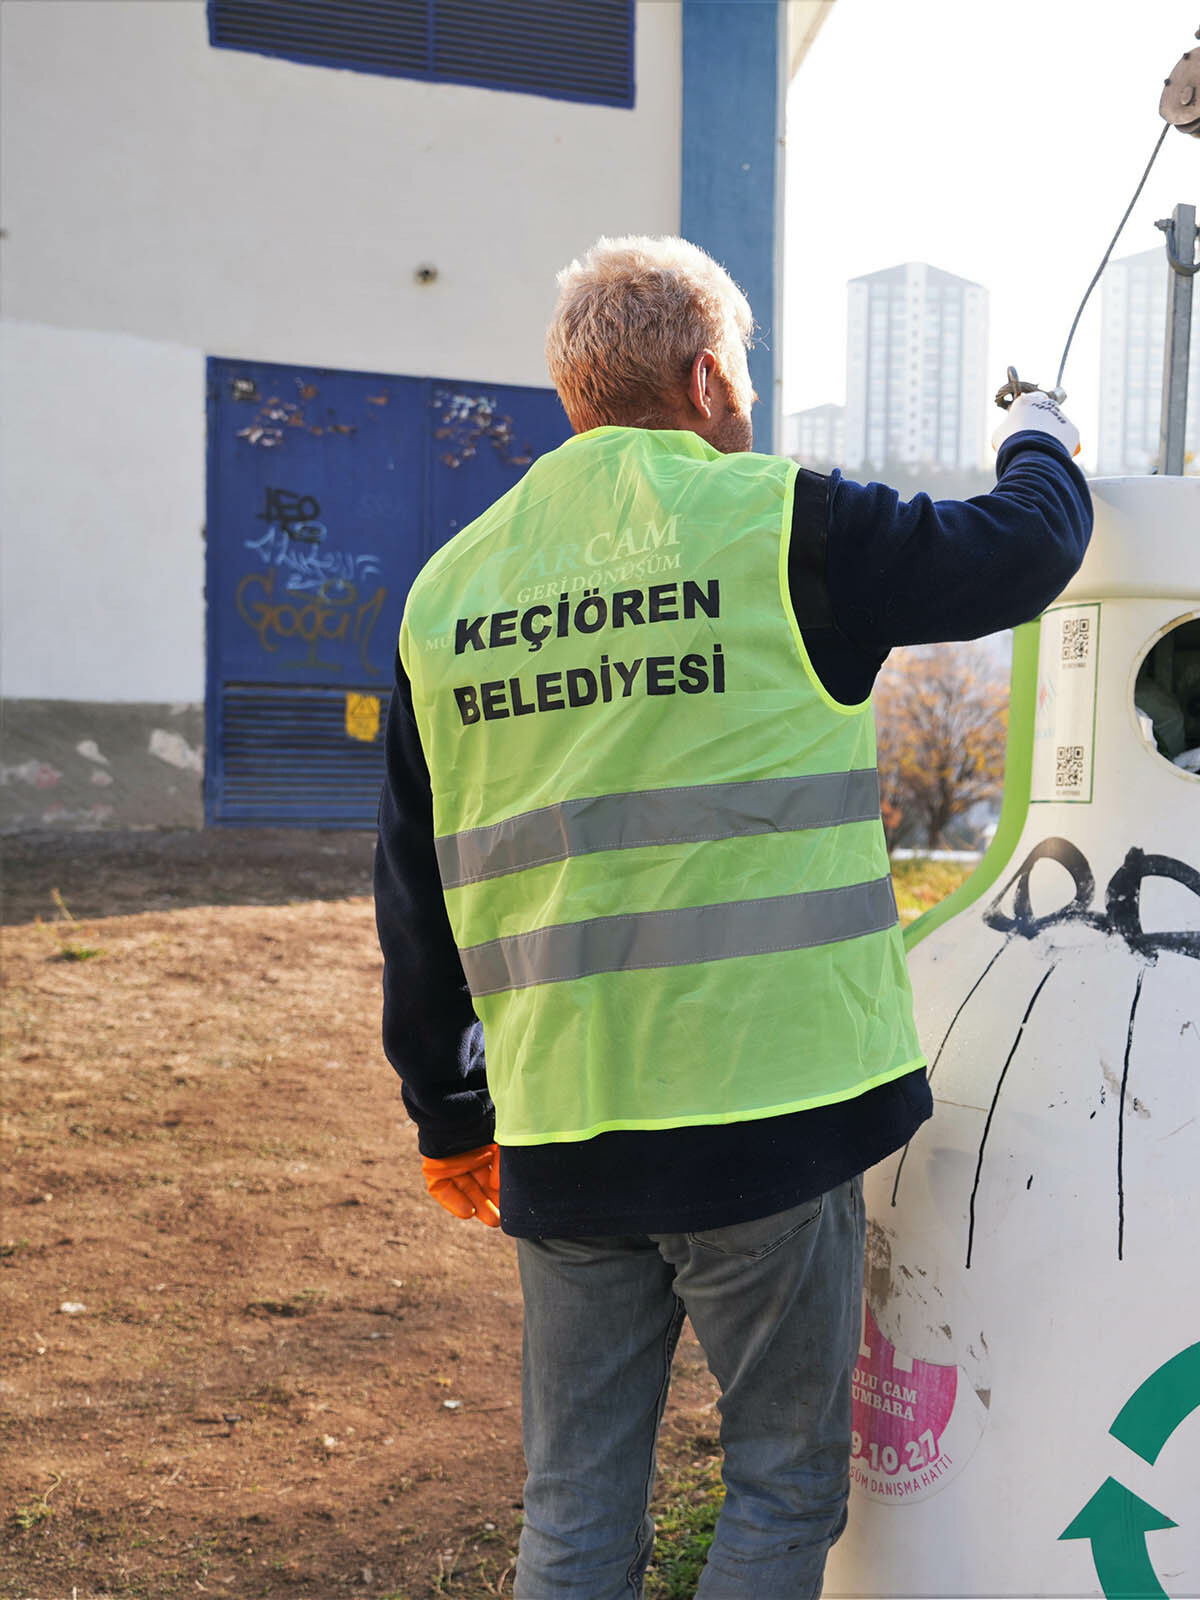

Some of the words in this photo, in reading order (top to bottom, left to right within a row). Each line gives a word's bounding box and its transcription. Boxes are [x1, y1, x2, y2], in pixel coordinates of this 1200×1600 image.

[454, 579, 720, 655] KEÇİÖREN
[453, 643, 726, 726] BELEDİYESİ
[882, 1381, 917, 1405] CAM
